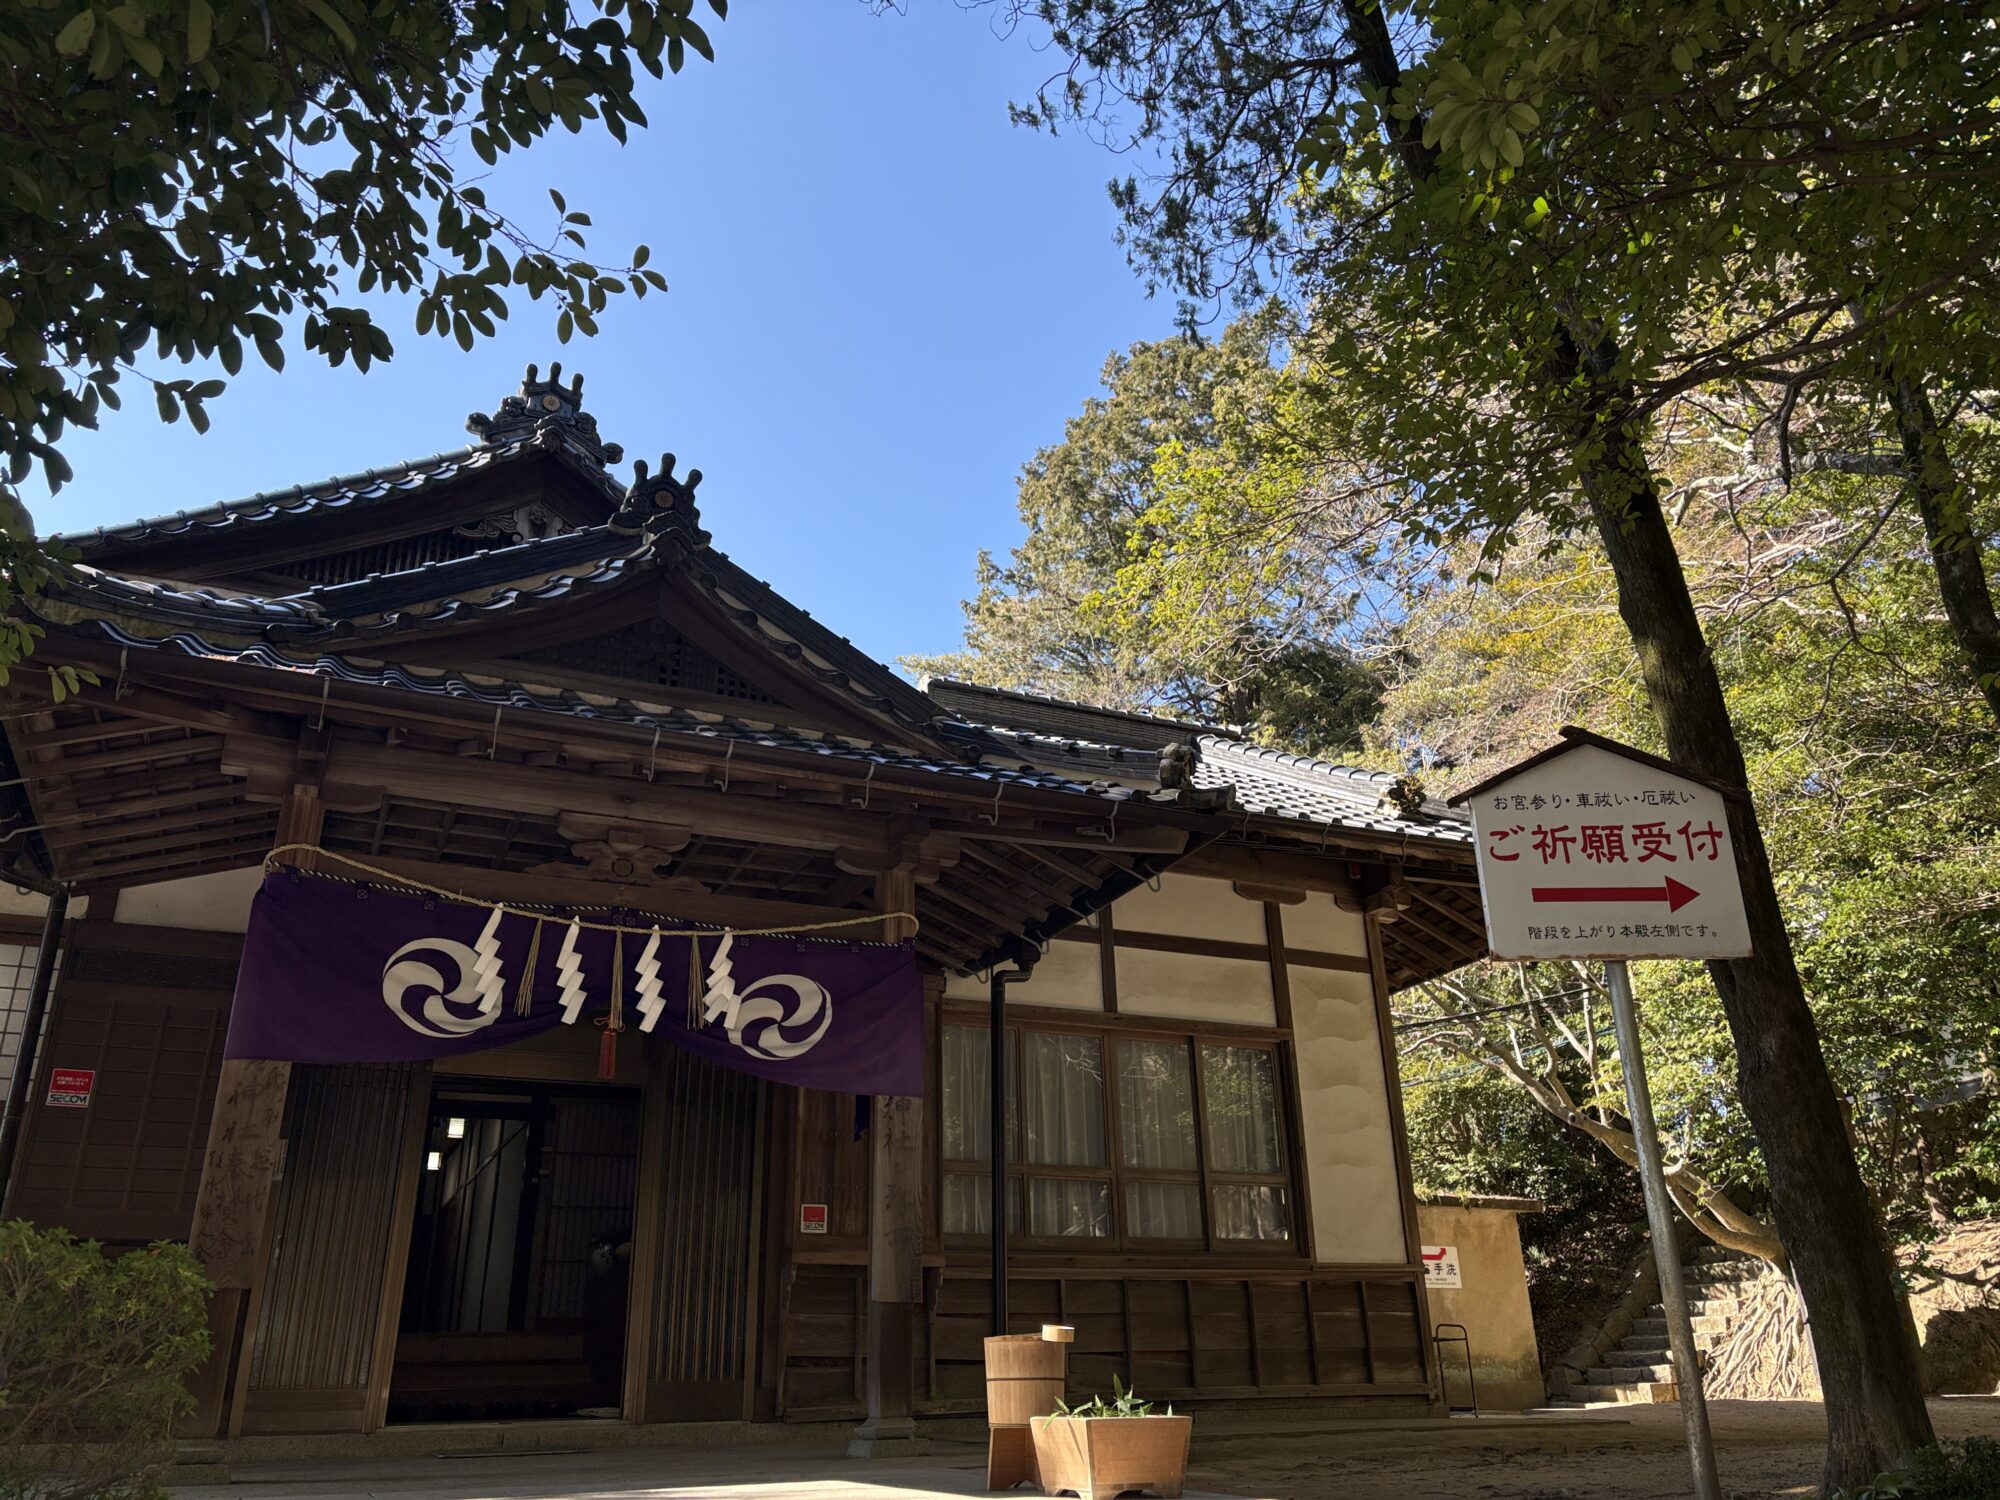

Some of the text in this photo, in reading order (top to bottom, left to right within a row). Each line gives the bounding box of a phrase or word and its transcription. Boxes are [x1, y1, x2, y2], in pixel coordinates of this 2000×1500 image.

[1489, 820, 1724, 865] ご祈願受付
[1528, 923, 1719, 941] 階段を上がり本殿左側です。
[50, 1094, 87, 1103] SECOM
